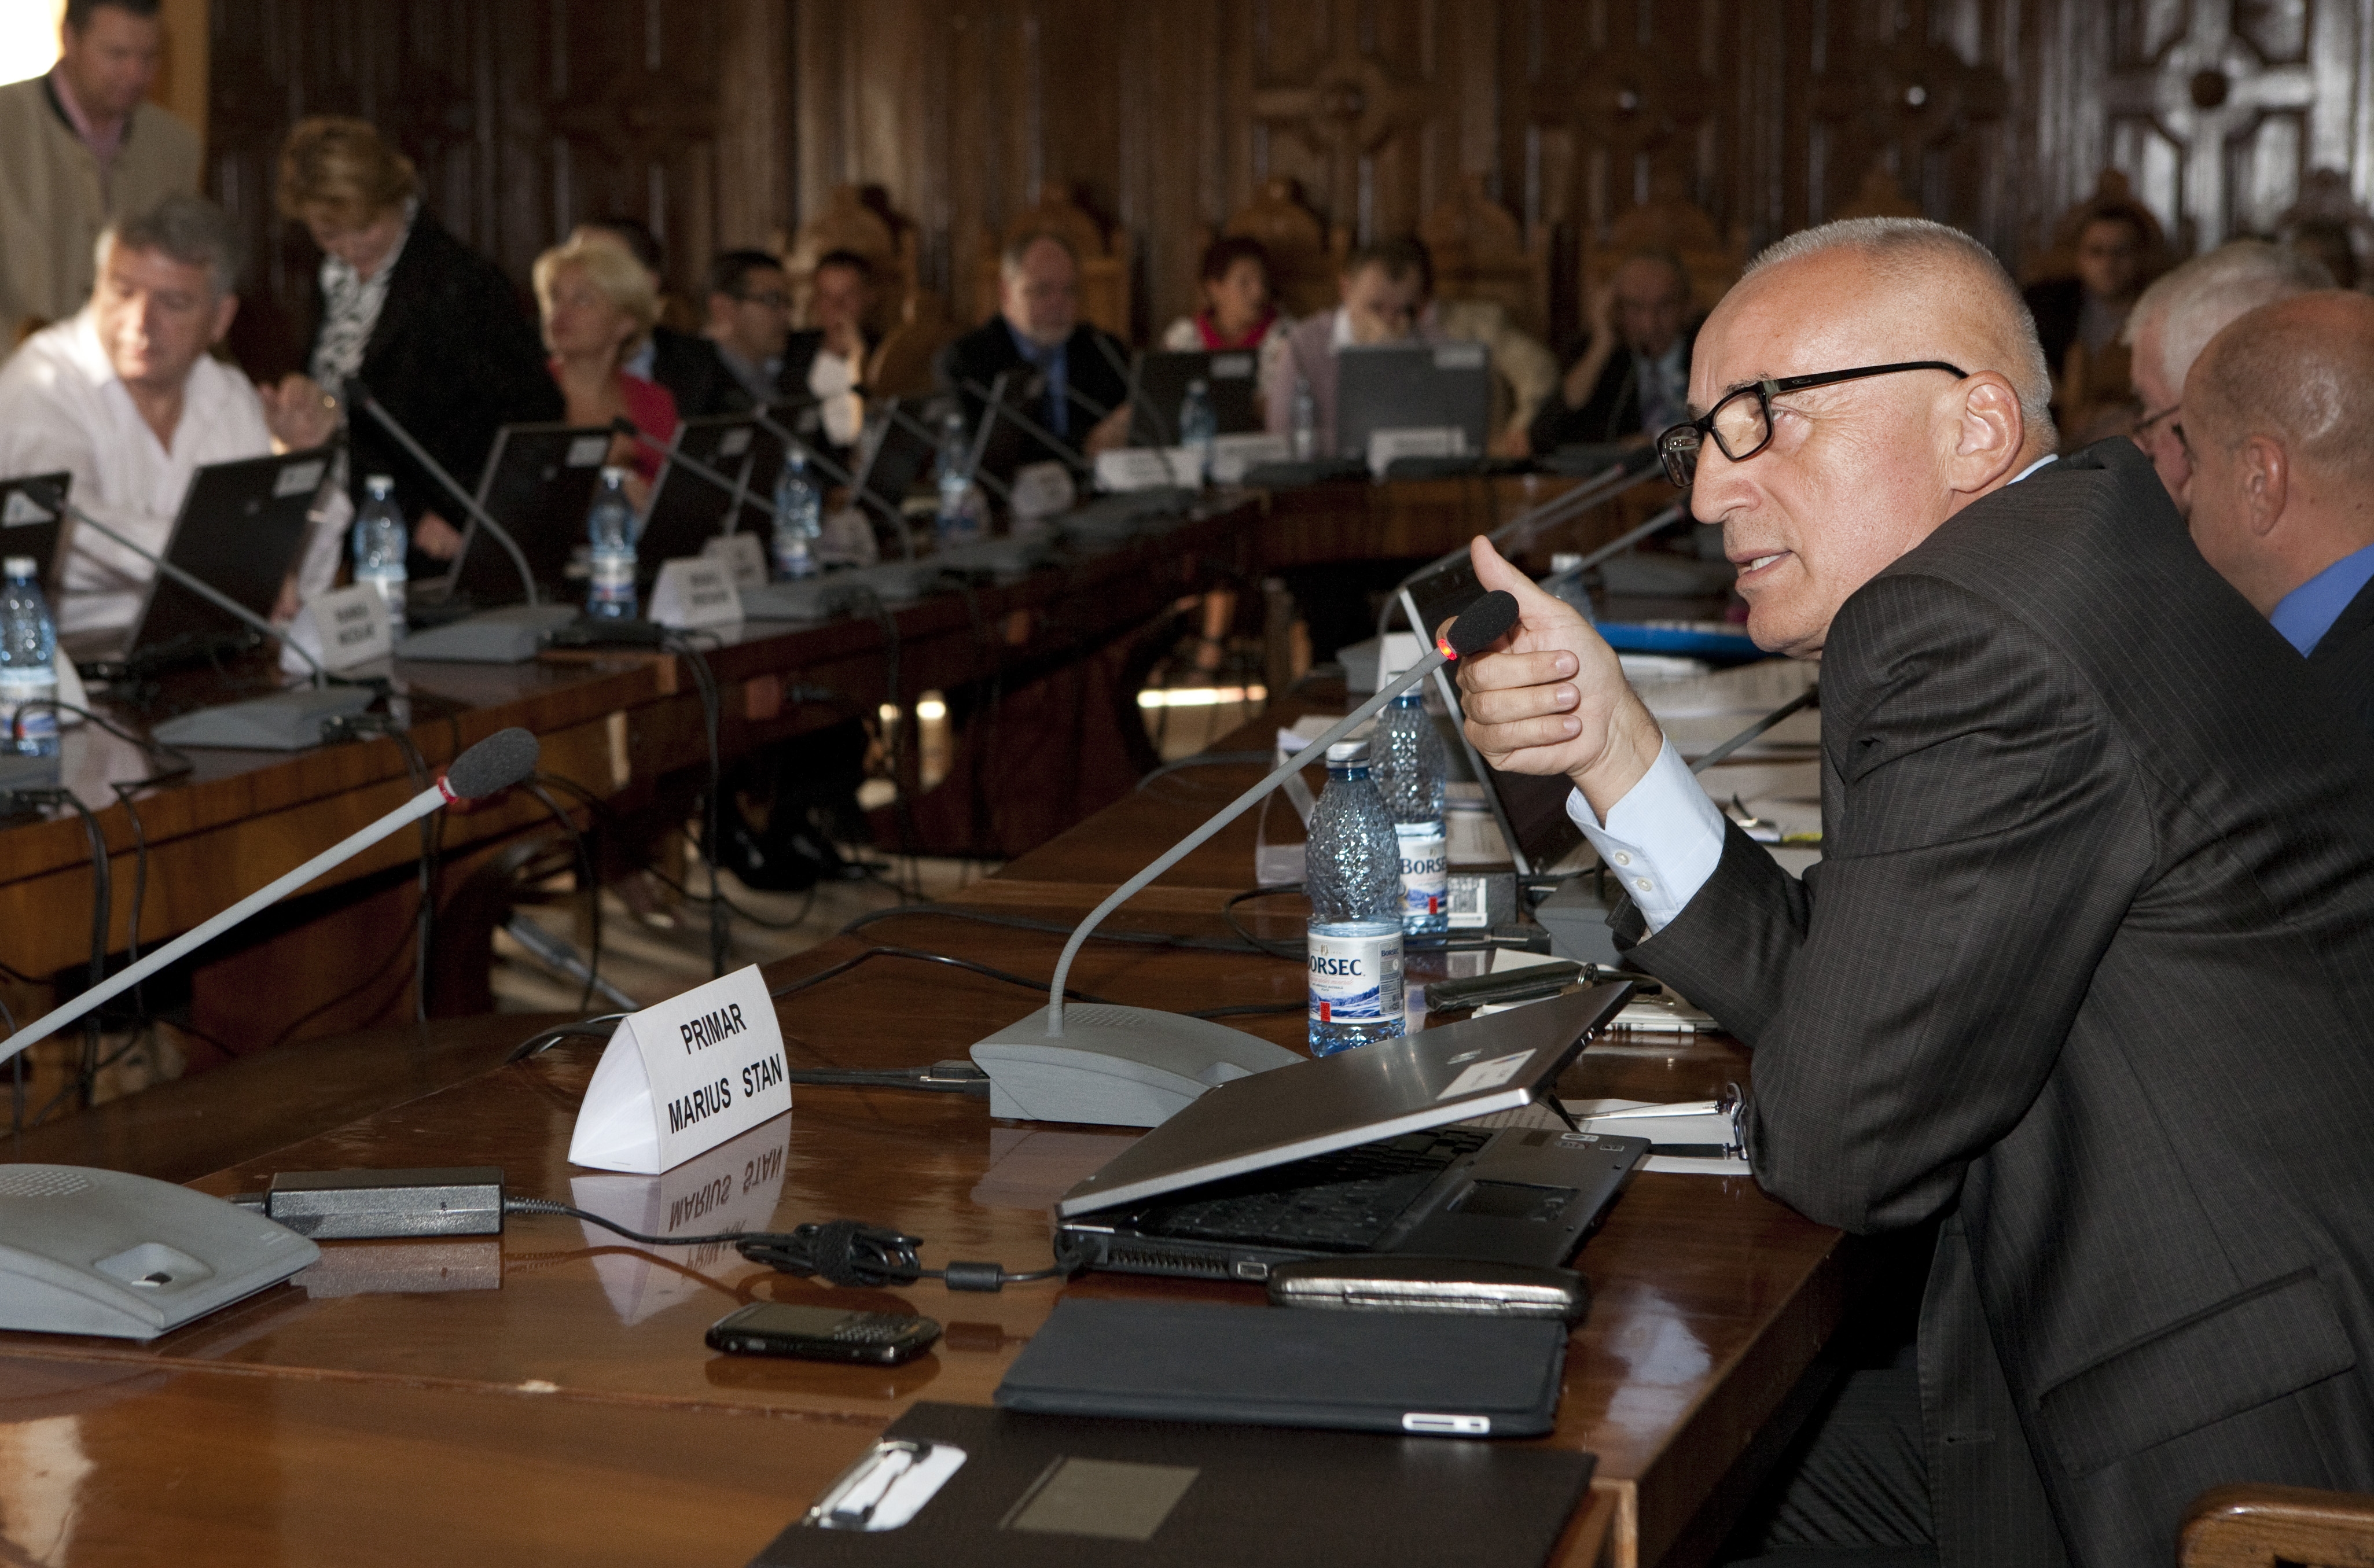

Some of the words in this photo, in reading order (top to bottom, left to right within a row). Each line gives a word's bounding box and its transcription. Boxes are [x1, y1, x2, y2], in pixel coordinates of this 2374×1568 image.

[1309, 955, 1362, 976] ORSEC
[679, 1003, 747, 1055] PRIMAR
[667, 1077, 732, 1135] MARIUS
[742, 1053, 782, 1098] STAN
